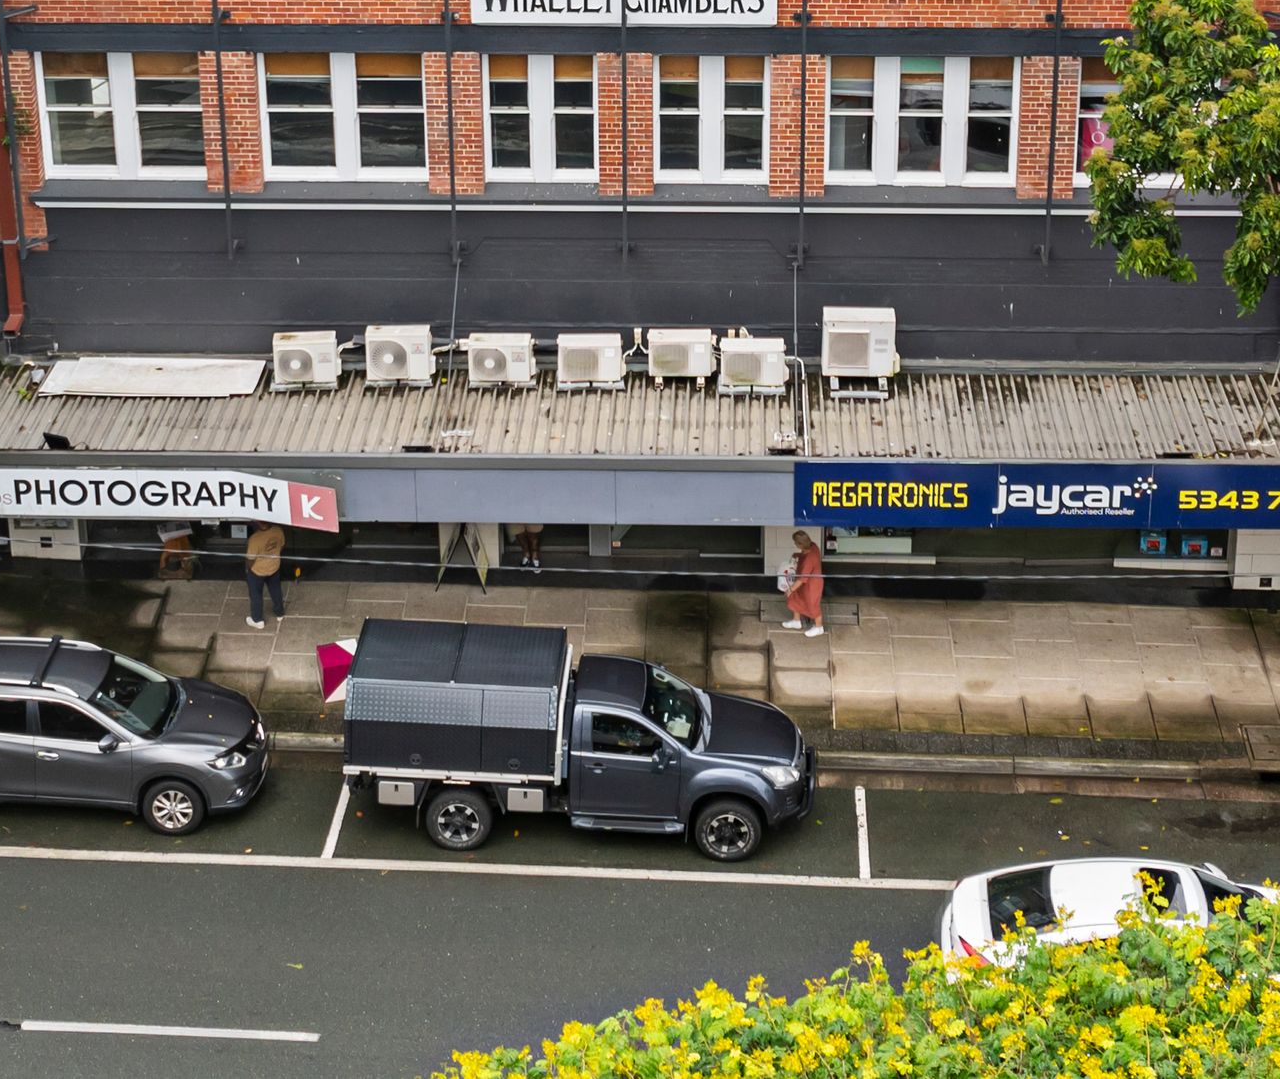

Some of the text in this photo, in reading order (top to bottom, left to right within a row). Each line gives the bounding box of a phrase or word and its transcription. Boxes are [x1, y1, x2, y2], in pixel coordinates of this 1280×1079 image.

[14, 478, 279, 513] PHOTOGRAPHY
[300, 493, 324, 522] K
[812, 481, 969, 509] MEGATRONICS
[991, 475, 1133, 516] jaycar
[1178, 490, 1260, 510] 5343
[1060, 507, 1136, 517] Authorised Reseller
